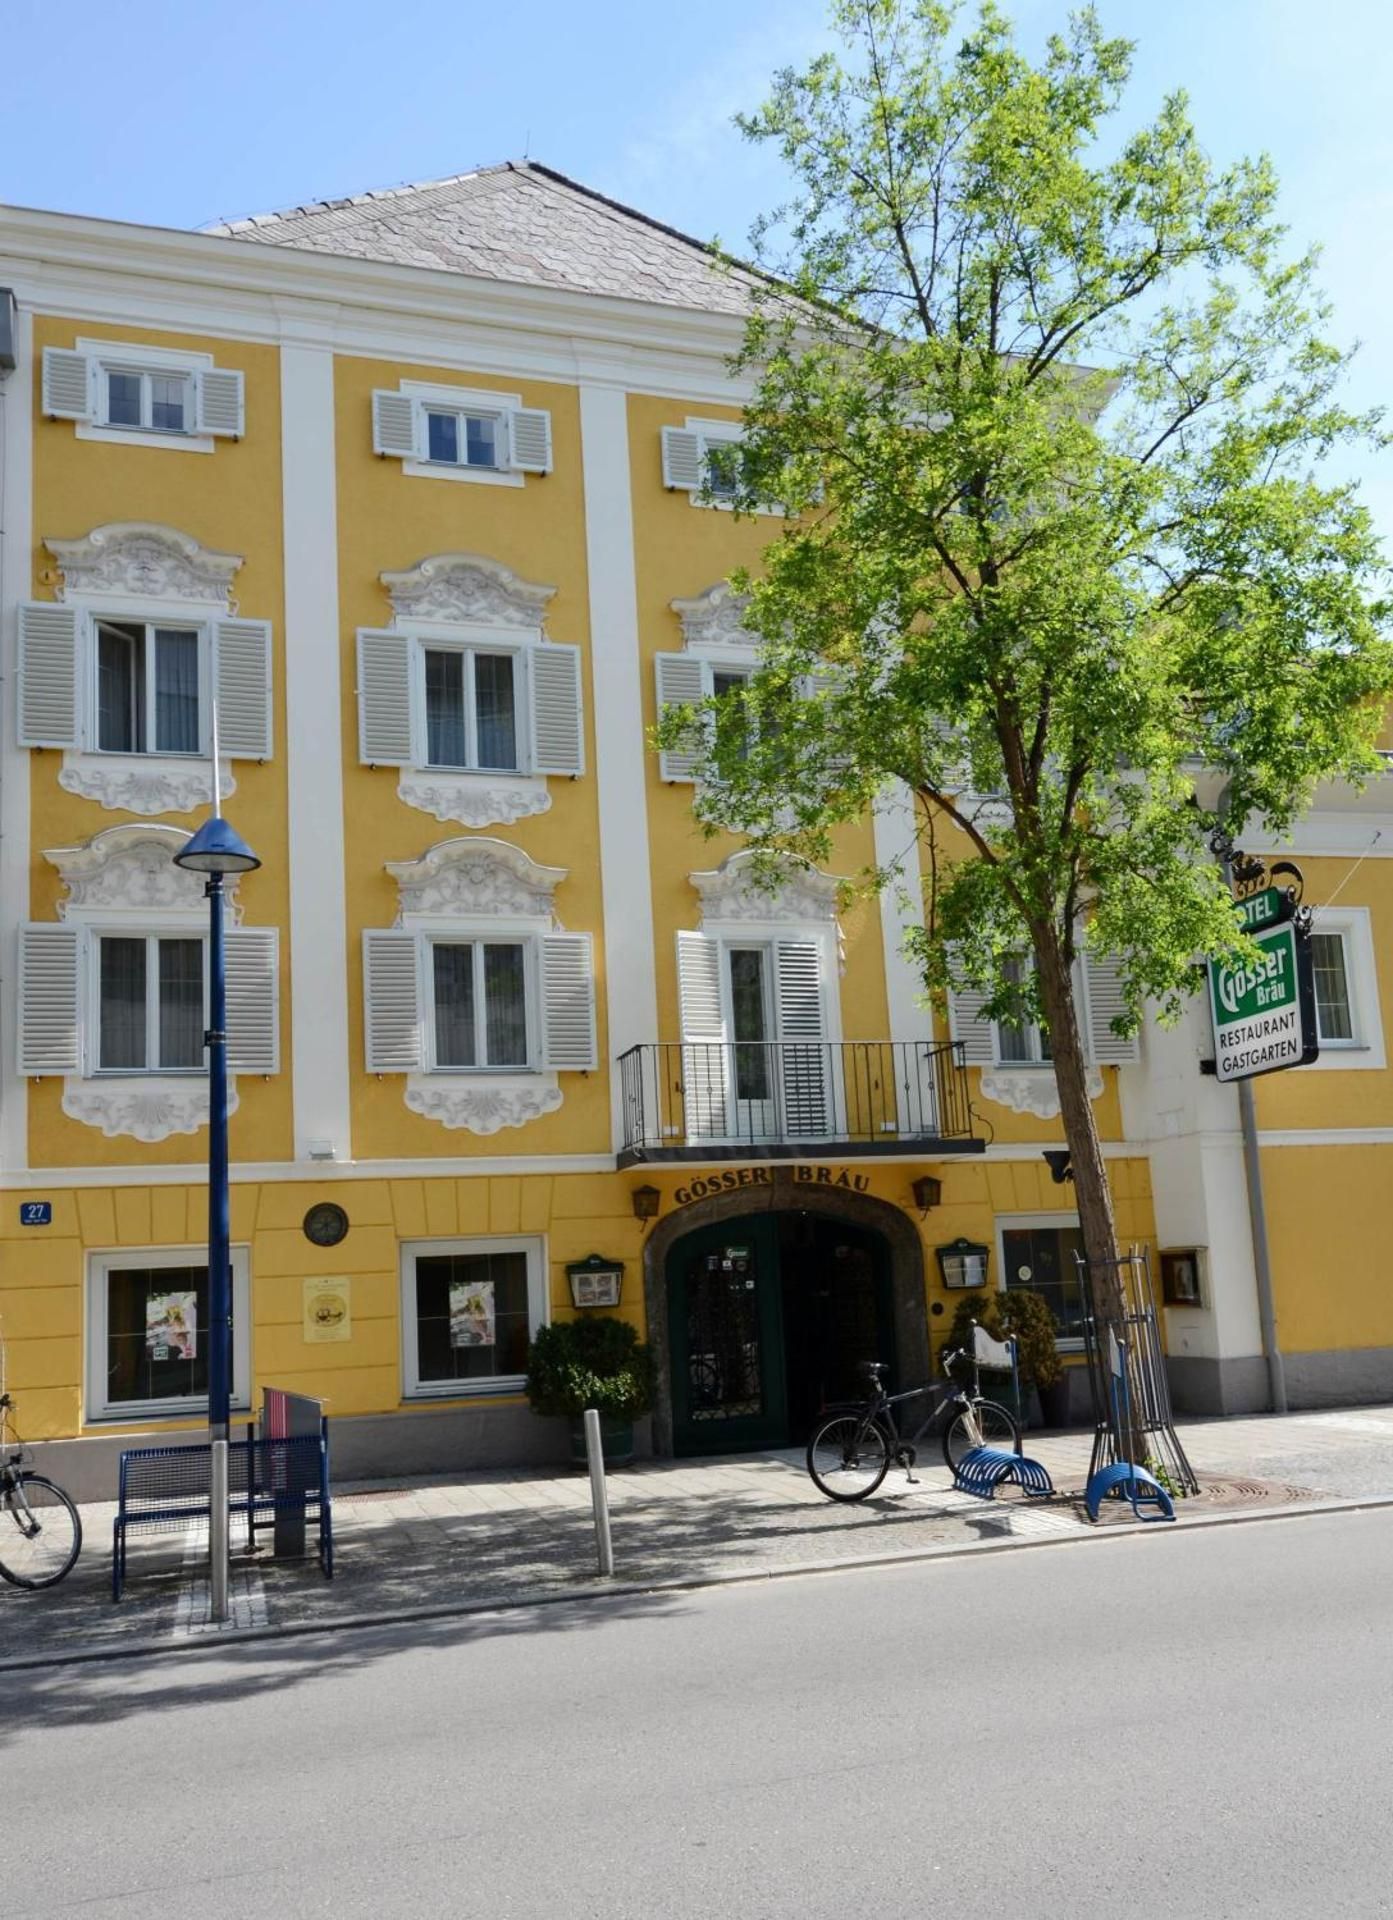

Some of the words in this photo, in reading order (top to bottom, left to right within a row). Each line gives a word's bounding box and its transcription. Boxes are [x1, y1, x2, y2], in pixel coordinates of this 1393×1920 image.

[1234, 895, 1273, 928] OTEL
[1256, 980, 1286, 1006] Bräu
[1219, 1012, 1296, 1048] RESTAURANT
[1222, 1038, 1297, 1072] GASTGARTEN
[674, 1167, 769, 1204] GÖSSER
[798, 1166, 870, 1192] BRÄU
[28, 1204, 44, 1219] 27
